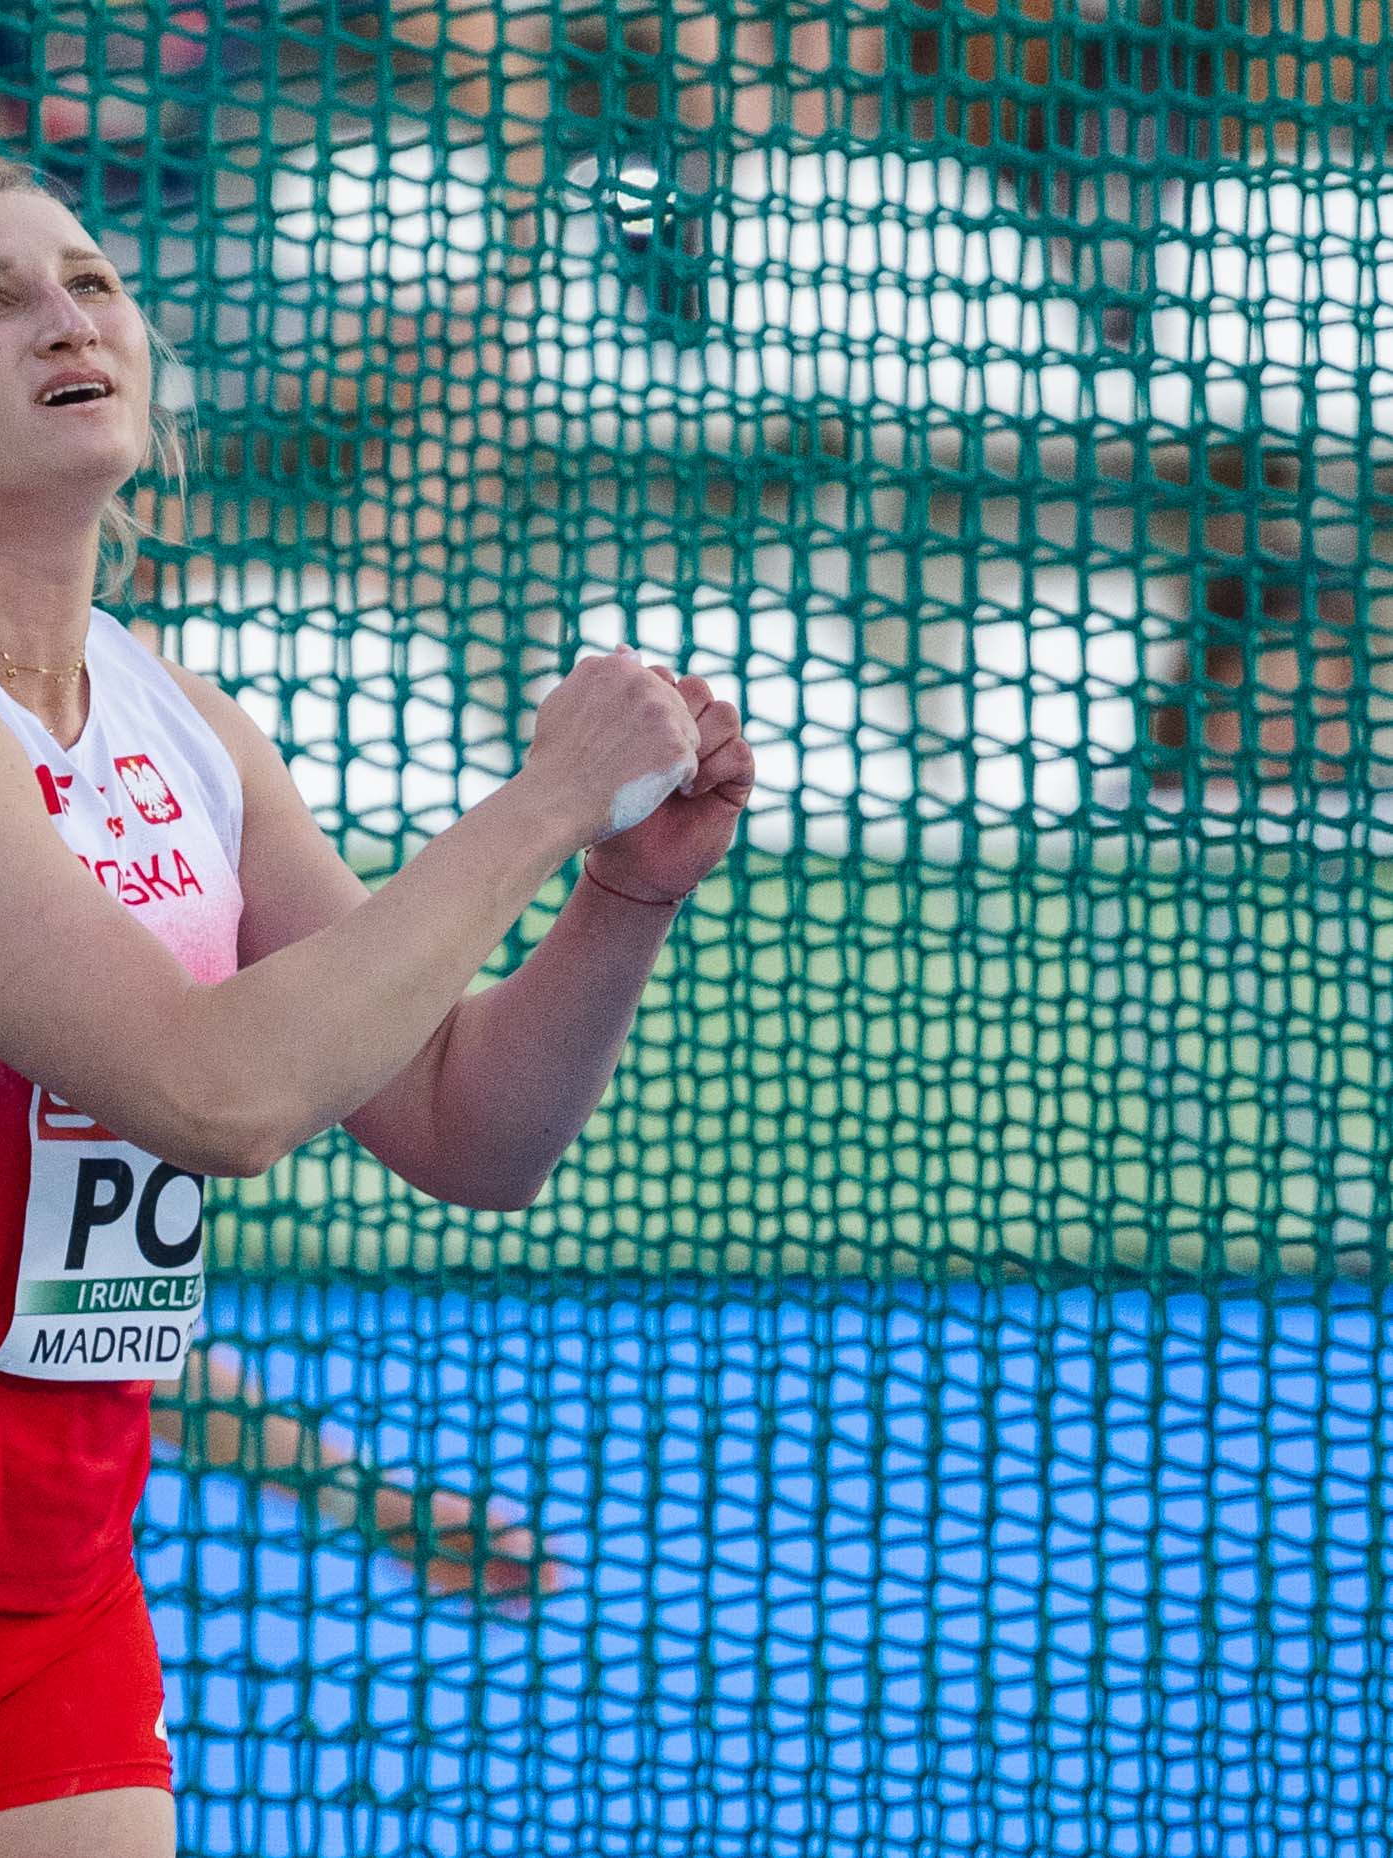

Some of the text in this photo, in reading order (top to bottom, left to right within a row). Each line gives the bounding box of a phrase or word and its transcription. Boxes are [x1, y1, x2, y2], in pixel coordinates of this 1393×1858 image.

[64, 1157, 203, 1270] PO
[78, 1282, 86, 1310] I
[89, 1281, 145, 1310] RUN
[29, 1326, 181, 1364] MADRID
